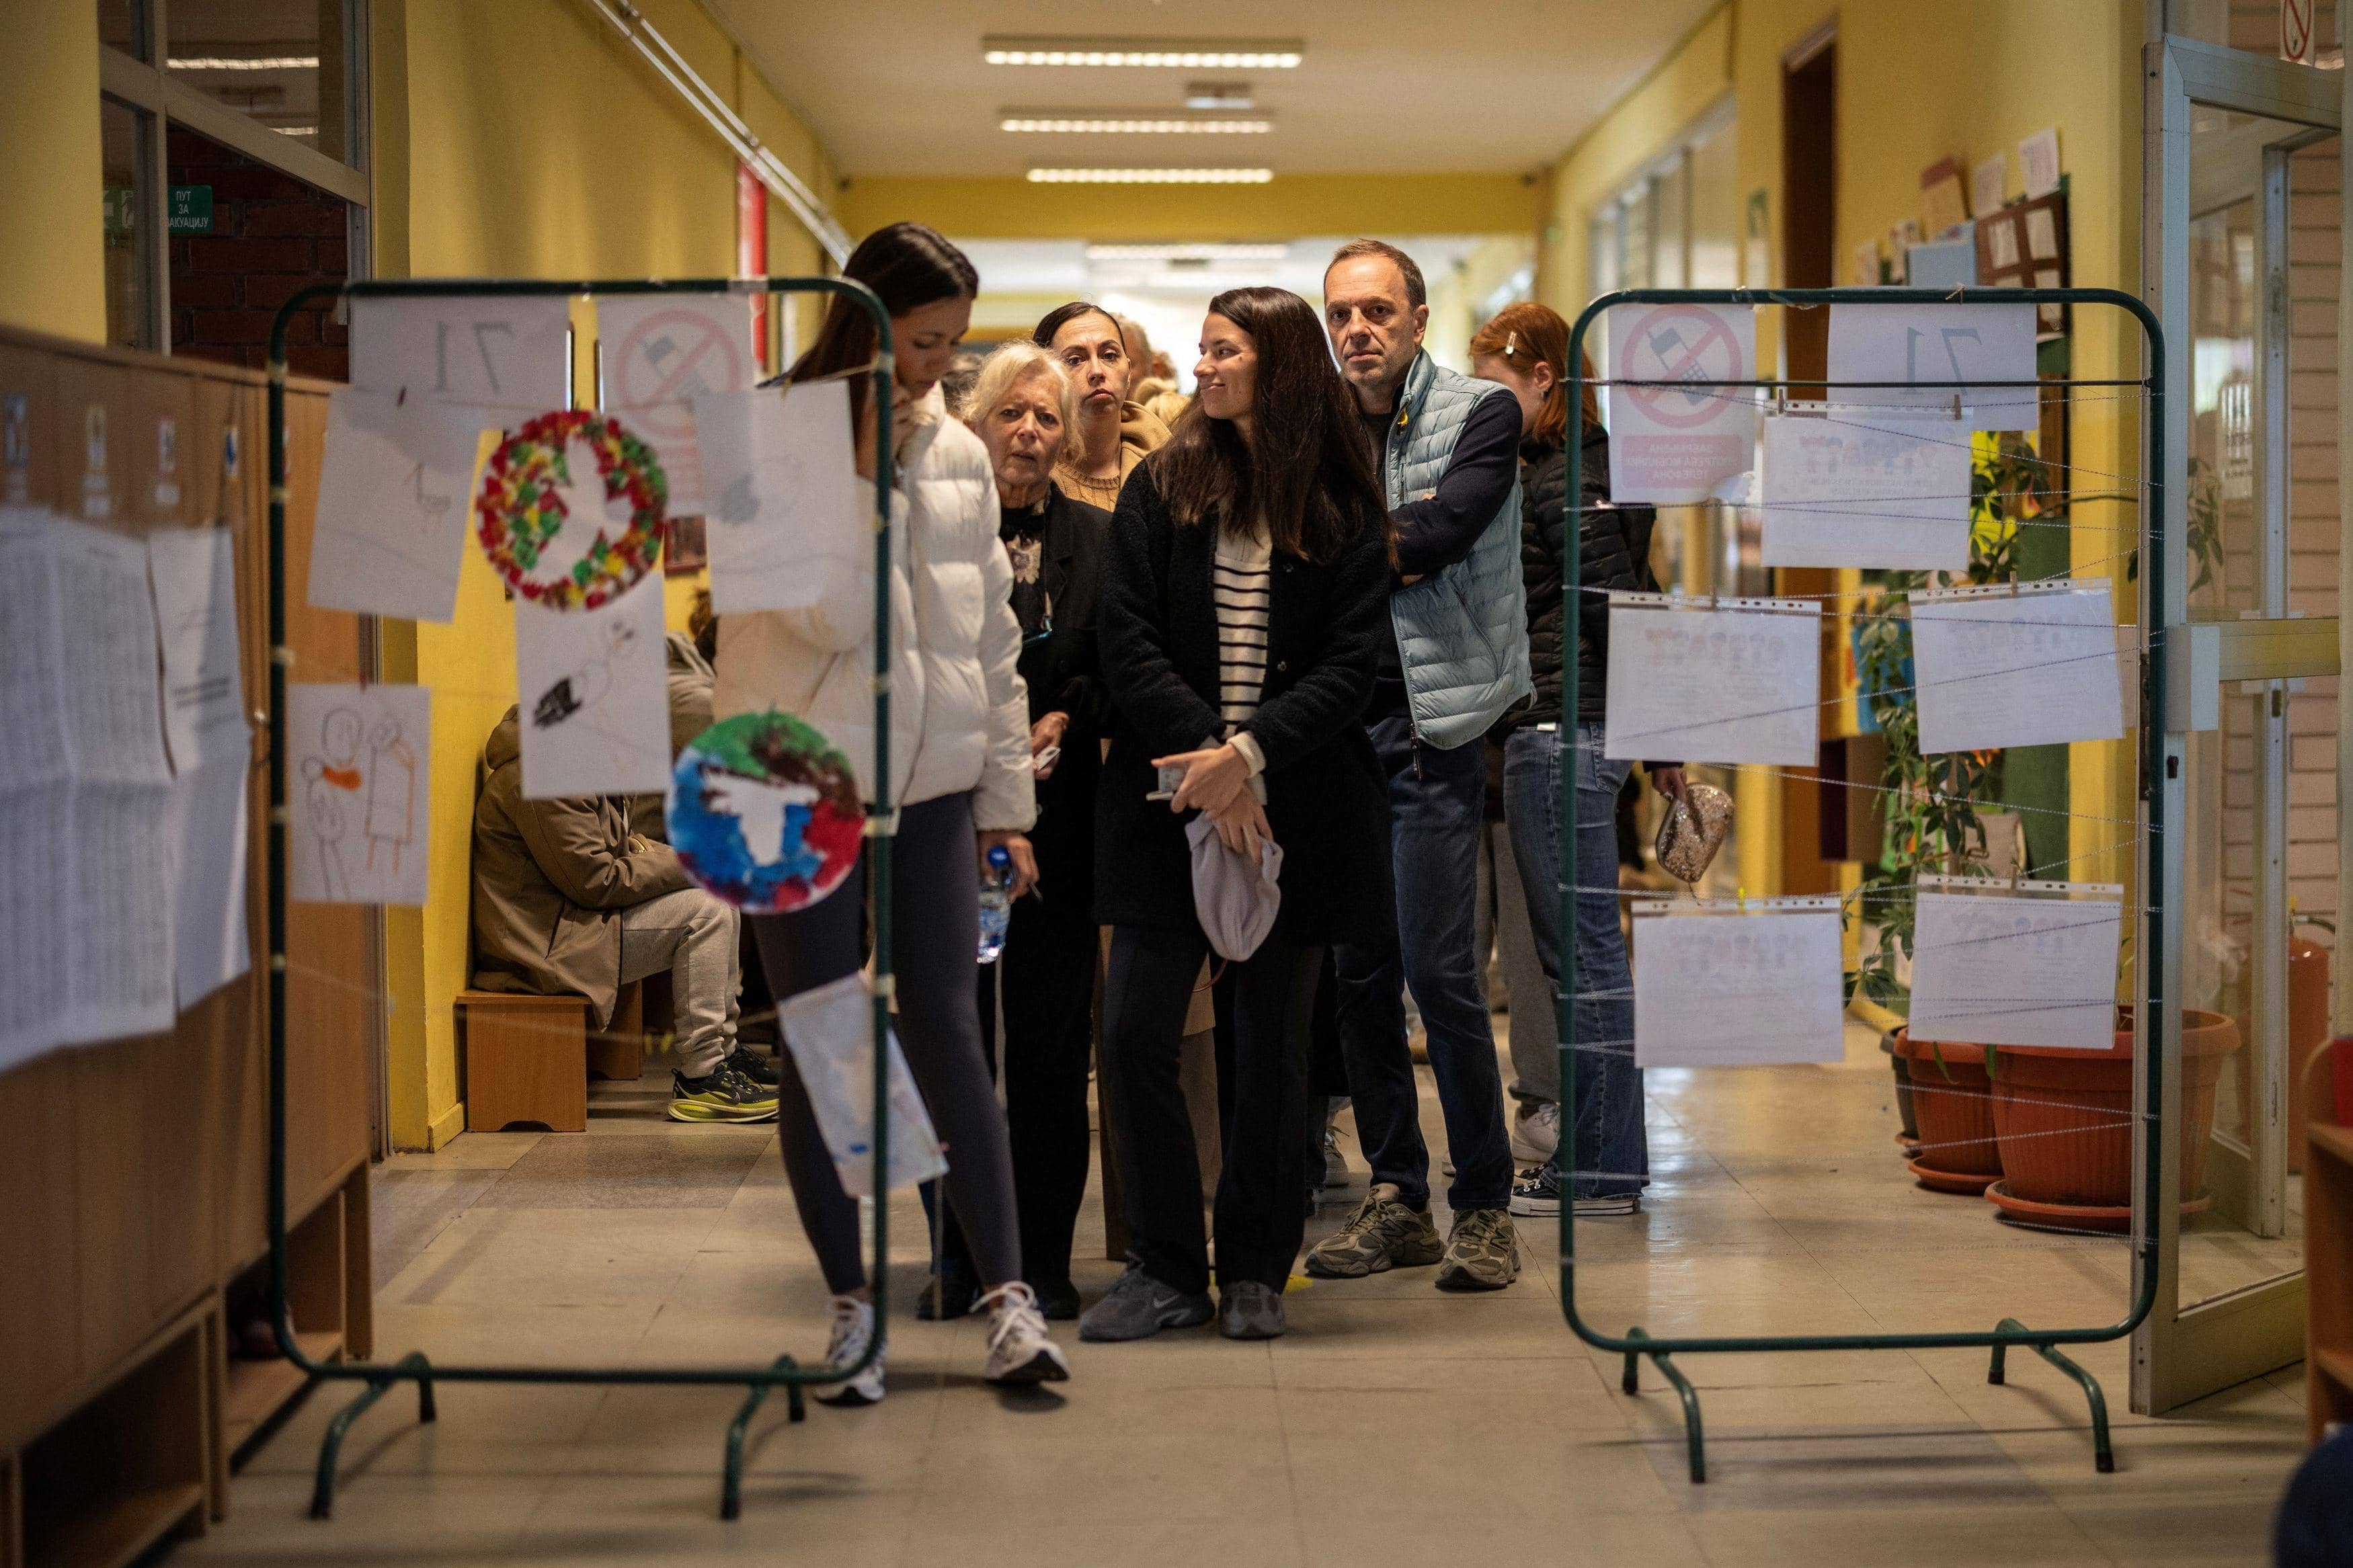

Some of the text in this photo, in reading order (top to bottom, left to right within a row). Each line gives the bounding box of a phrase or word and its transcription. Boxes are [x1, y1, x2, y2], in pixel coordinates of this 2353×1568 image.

[176, 191, 191, 202] ПУТ
[178, 204, 189, 214] ЗА
[169, 217, 208, 229] АКУАЦИЈУ
